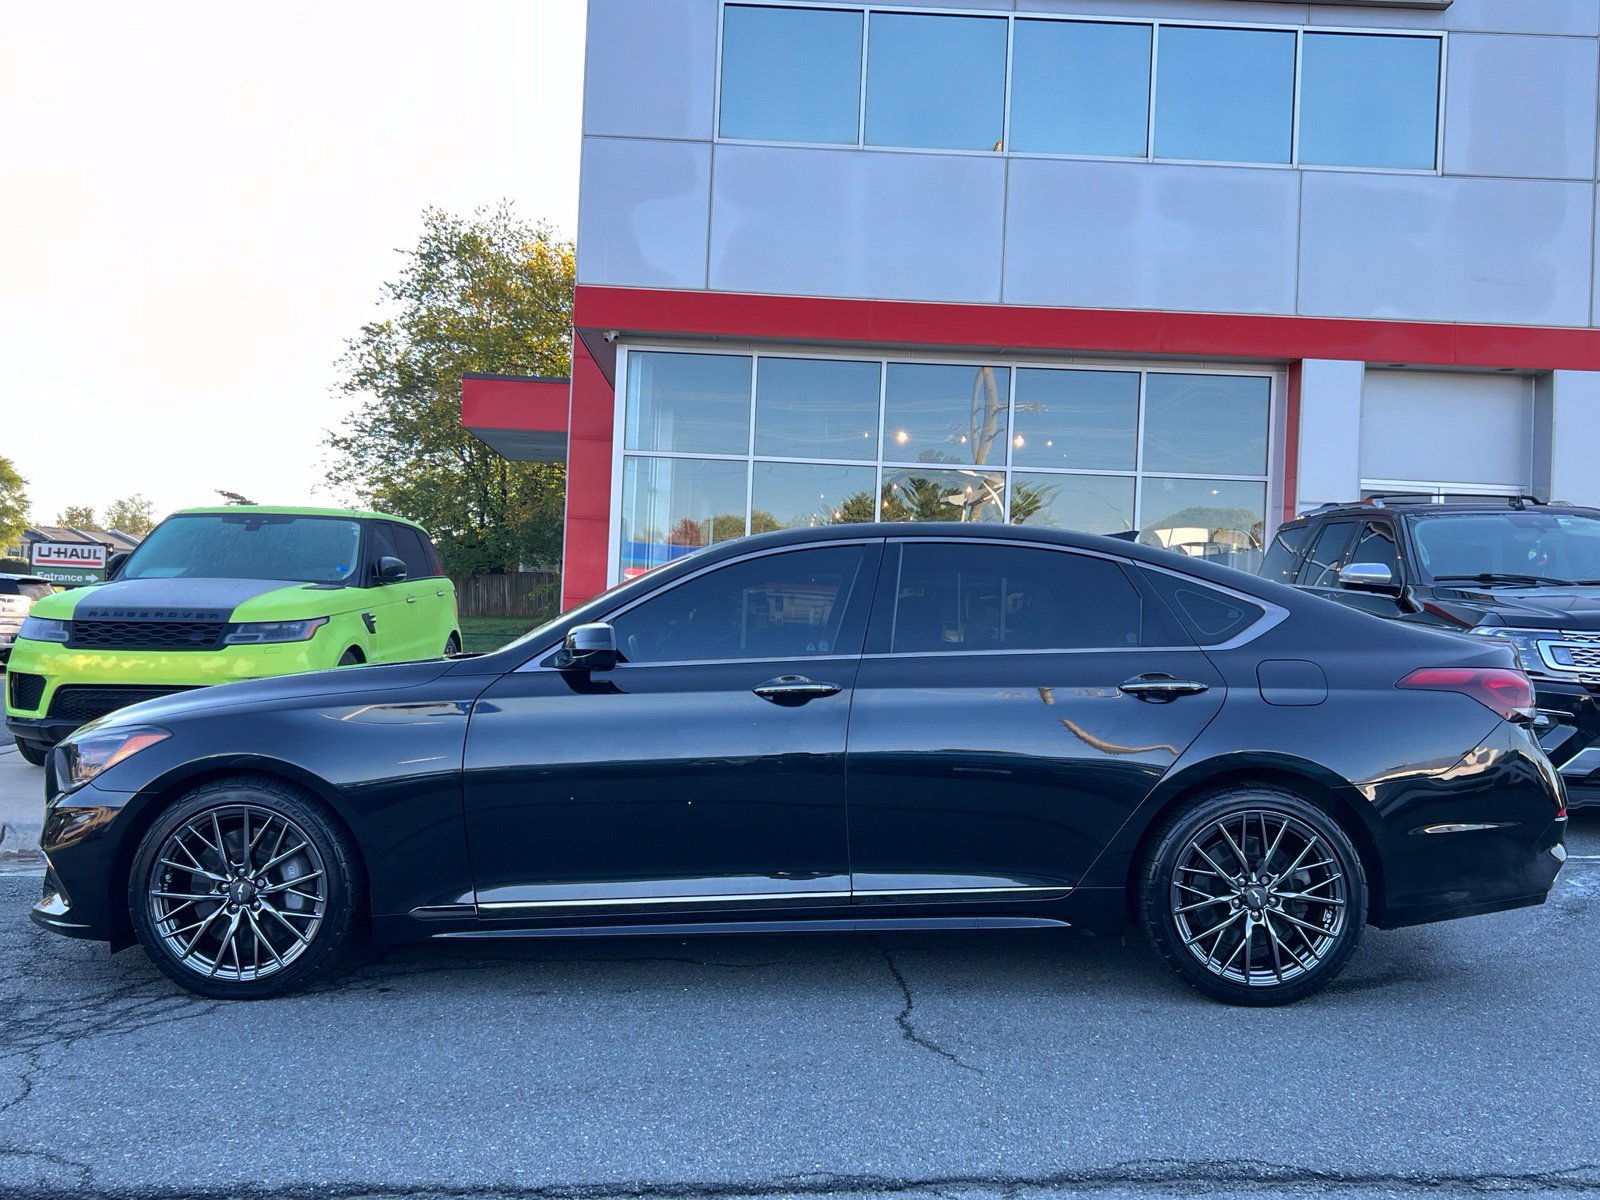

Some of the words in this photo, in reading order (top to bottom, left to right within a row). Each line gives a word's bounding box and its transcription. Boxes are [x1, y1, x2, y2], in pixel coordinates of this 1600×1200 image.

[38, 546, 102, 560] U-HAUL
[37, 571, 83, 583] Entrance
[154, 611, 219, 619] ROVER
